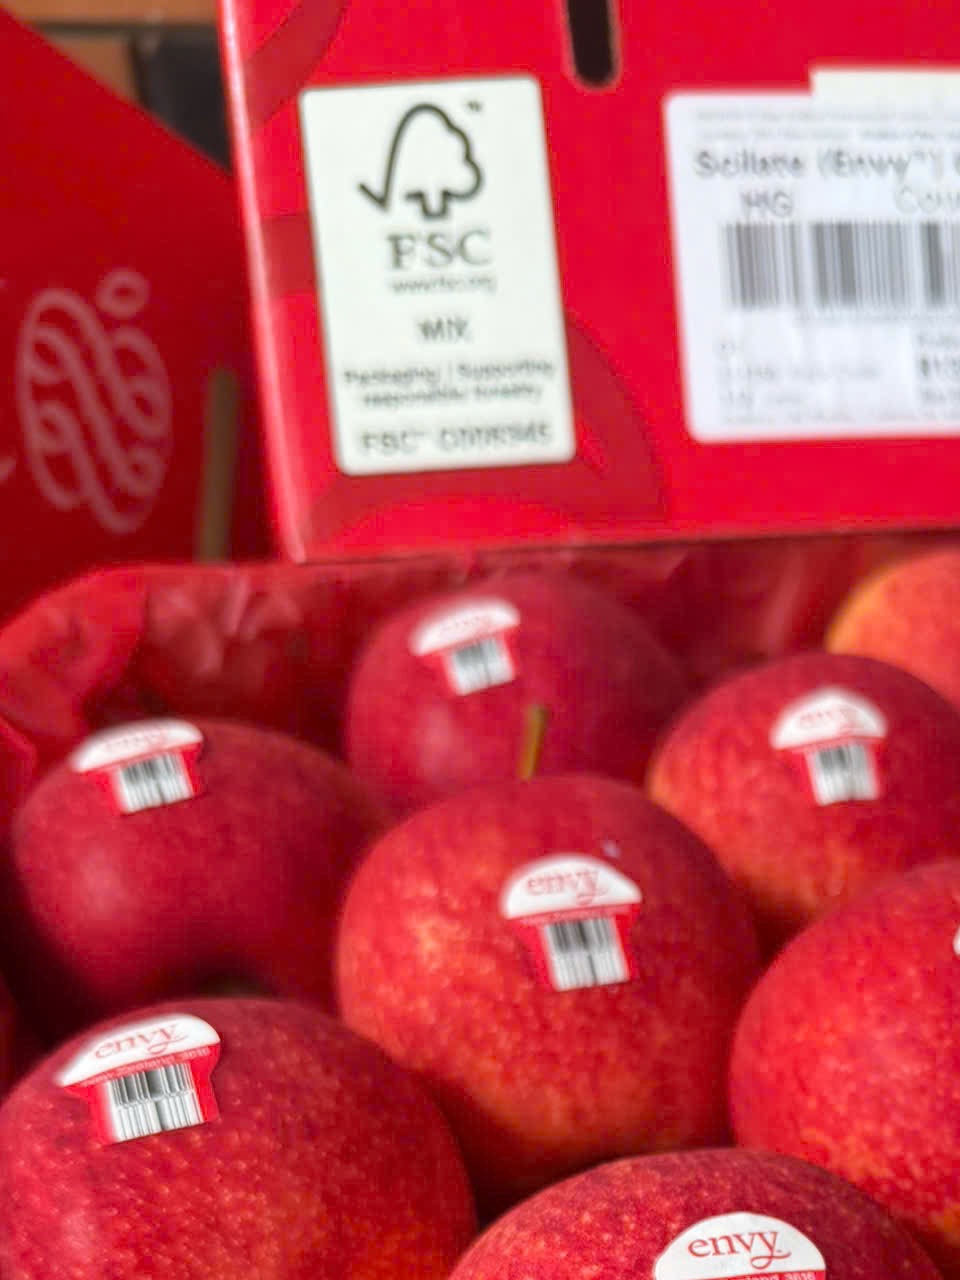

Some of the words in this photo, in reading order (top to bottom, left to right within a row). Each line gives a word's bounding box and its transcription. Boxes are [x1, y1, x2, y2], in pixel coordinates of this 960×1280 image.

[386, 228, 491, 270] FSC
[416, 316, 471, 341] MIX
[95, 1023, 189, 1059] envy
[687, 1231, 792, 1270] envy
